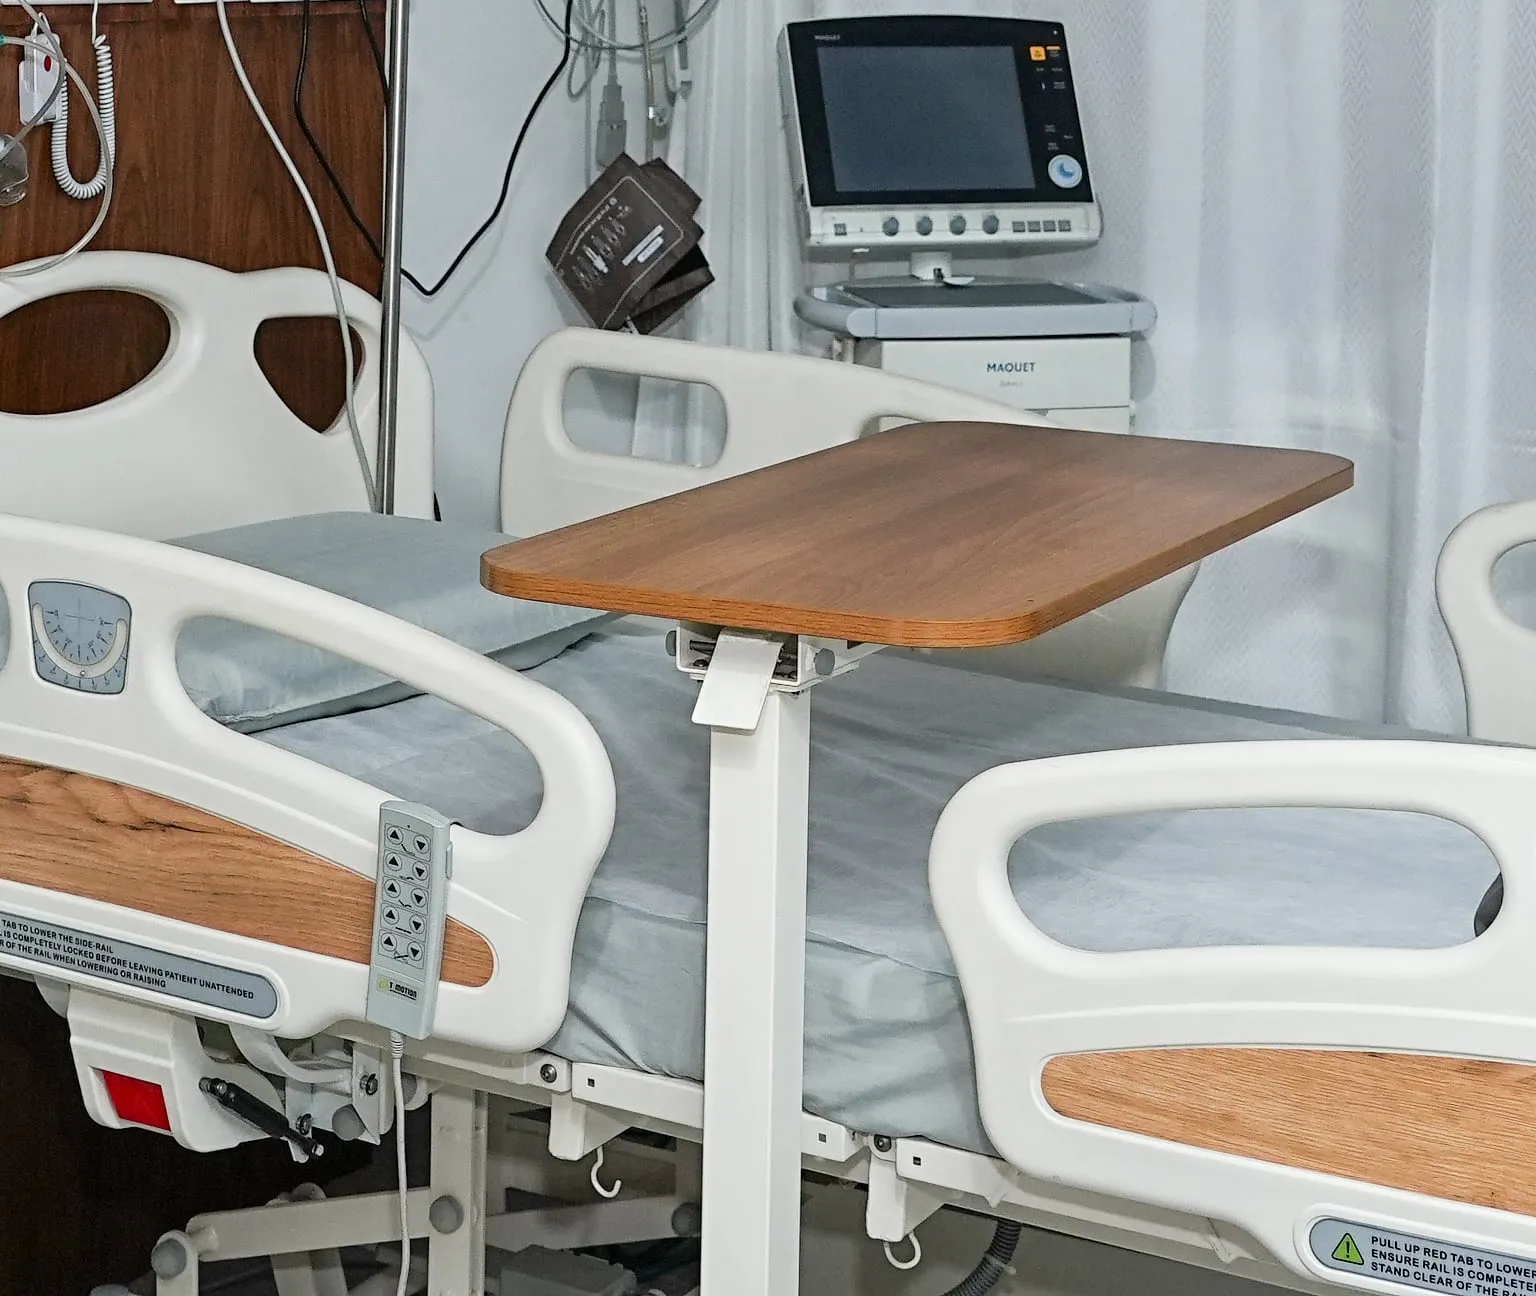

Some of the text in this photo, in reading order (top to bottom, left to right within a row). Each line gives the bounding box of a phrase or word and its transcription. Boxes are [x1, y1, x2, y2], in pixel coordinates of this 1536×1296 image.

[986, 362, 1036, 373] MAQUET
[2, 919, 17, 930] TAB
[18, 923, 29, 932] TO
[29, 925, 57, 939] LOWER
[58, 933, 74, 944] THE
[74, 937, 114, 954] SIDE-RAIL
[3, 930, 11, 939] IS
[12, 932, 62, 951] COMPLETELY
[63, 944, 94, 959] LOCKED
[95, 953, 128, 967] BEFORE
[128, 961, 163, 977] LEAVING
[164, 970, 198, 985] PATIENT
[199, 979, 254, 999] UNATTENDED
[5, 940, 16, 949] OF
[17, 943, 33, 954] THE
[33, 948, 51, 959] RAIL
[52, 952, 76, 965] WHEN
[77, 959, 119, 976] LOWERING
[119, 970, 132, 980] OR
[133, 973, 166, 988] RAISING
[1371, 1236, 1402, 1251] PULL
[1404, 1242, 1420, 1254] UP
[1423, 1247, 1448, 1260] RED
[1450, 1252, 1474, 1266] TAB
[1476, 1258, 1493, 1270] TO
[1371, 1248, 1420, 1268] ENSURE
[1422, 1259, 1450, 1274] RAIL
[1453, 1266, 1465, 1277] IS
[1371, 1261, 1410, 1278] STAND
[1413, 1271, 1453, 1288] CLEAR
[1456, 1280, 1472, 1291] OF
[1474, 1284, 1499, 1296] THE
